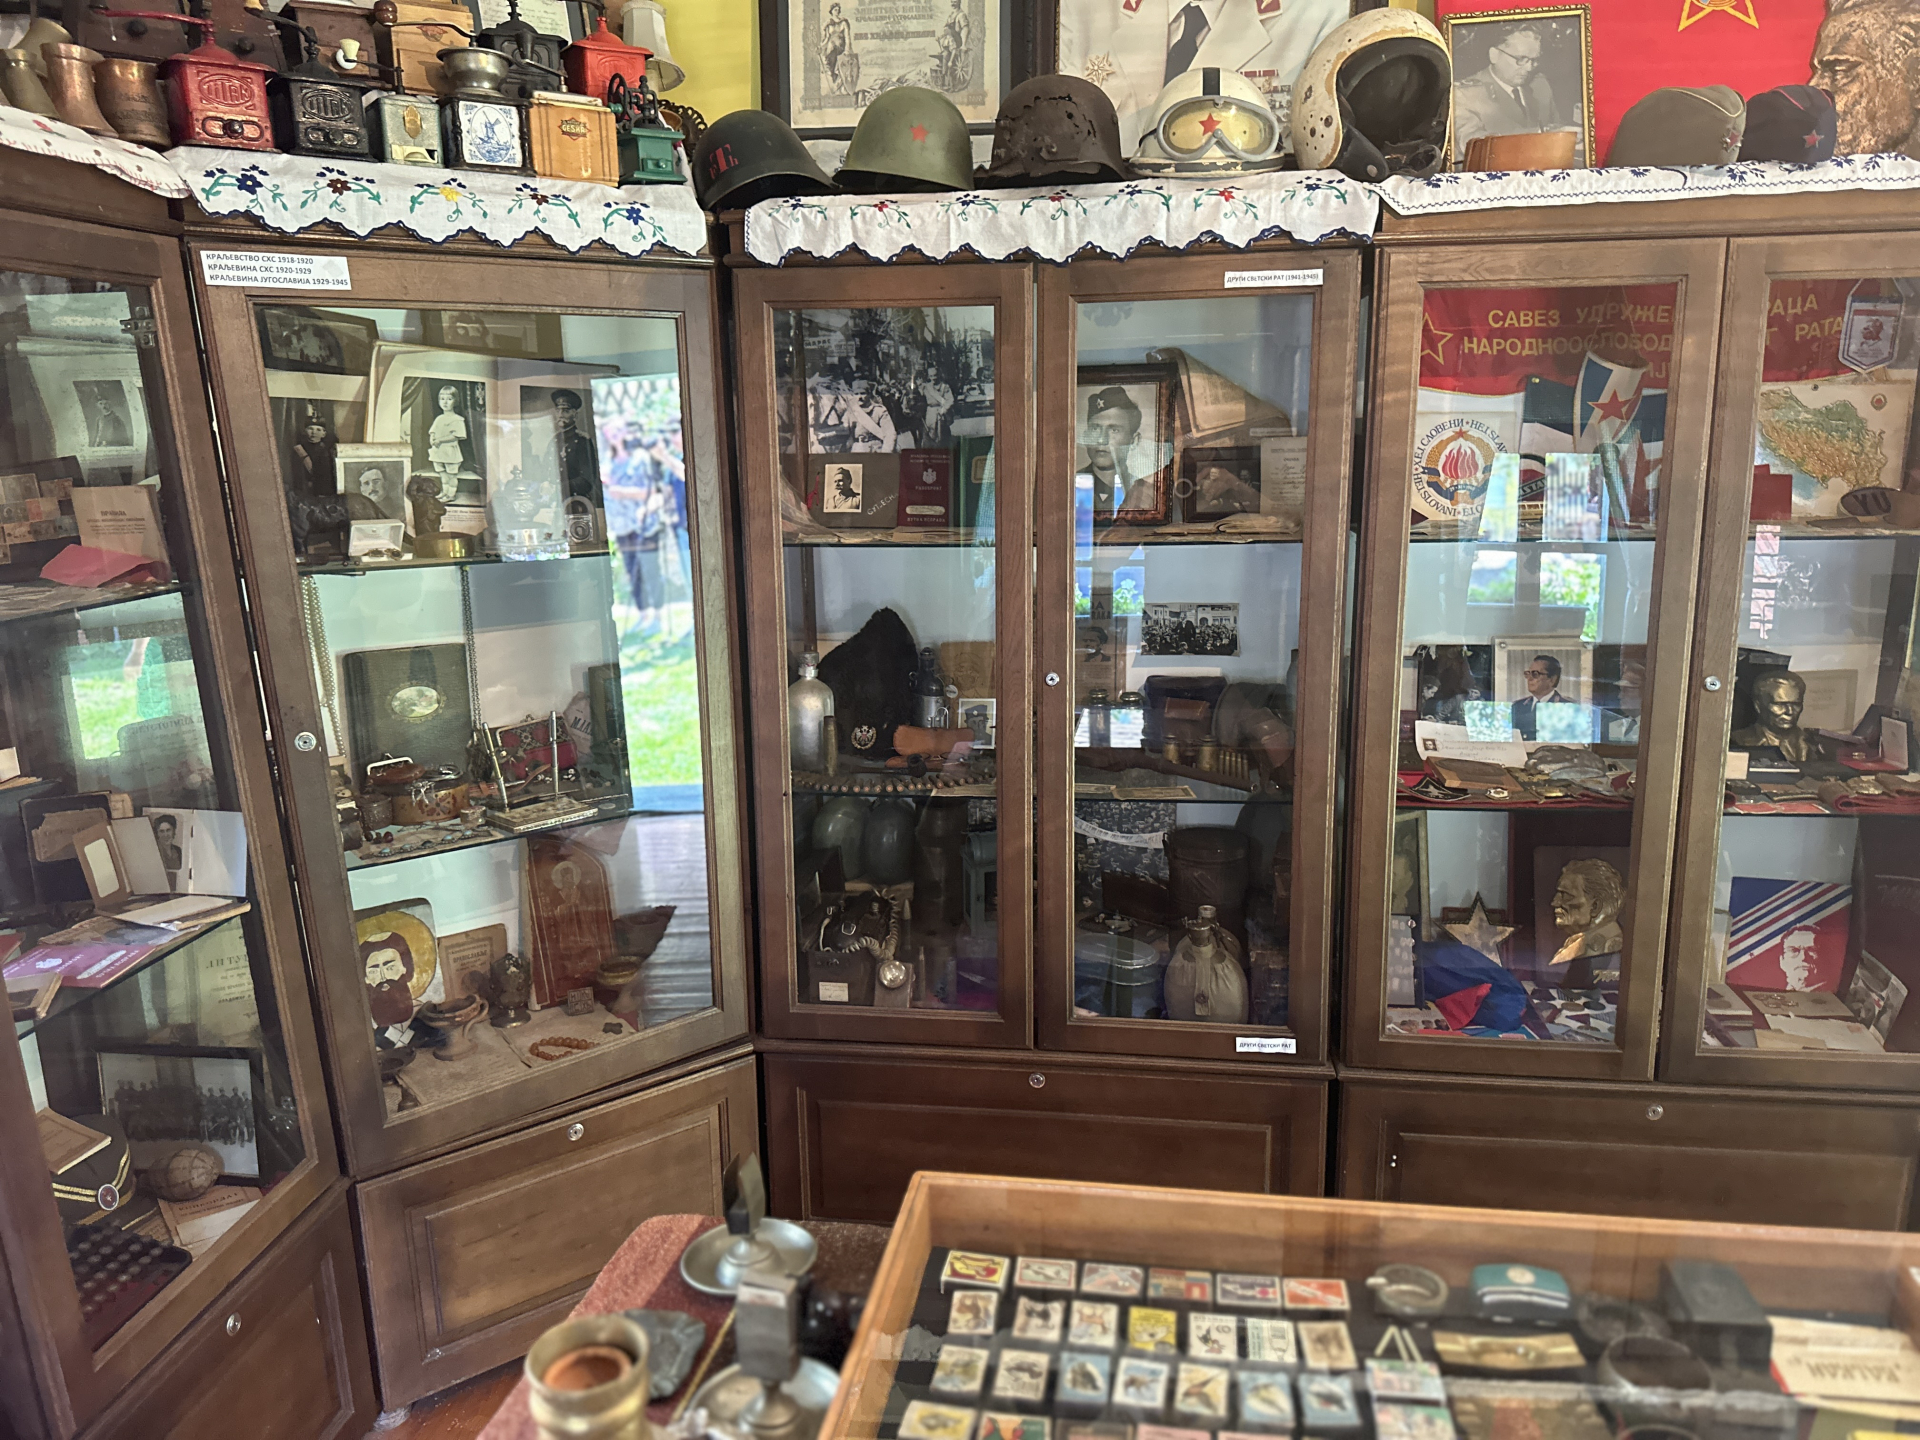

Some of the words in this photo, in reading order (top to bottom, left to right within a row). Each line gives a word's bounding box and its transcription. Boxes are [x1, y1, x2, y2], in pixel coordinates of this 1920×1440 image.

[206, 253, 259, 262] КРАЉЕВСТВО
[261, 255, 276, 263] СХС
[278, 256, 314, 264] 1918-1920
[208, 264, 257, 272] КРАЉЕВИНА
[276, 266, 312, 274] 1920-1929
[209, 274, 259, 283] КРАЉЕВИНА
[260, 276, 311, 285] ЈУГОСЛАВИЈА
[312, 278, 348, 286] 1929-1945
[1285, 273, 1319, 281] (1941-1945)
[1768, 293, 1818, 317] АЦА
[1488, 309, 1561, 328] САВЕЗ
[1795, 316, 1843, 342] РАТА
[1852, 490, 1892, 515] YU
